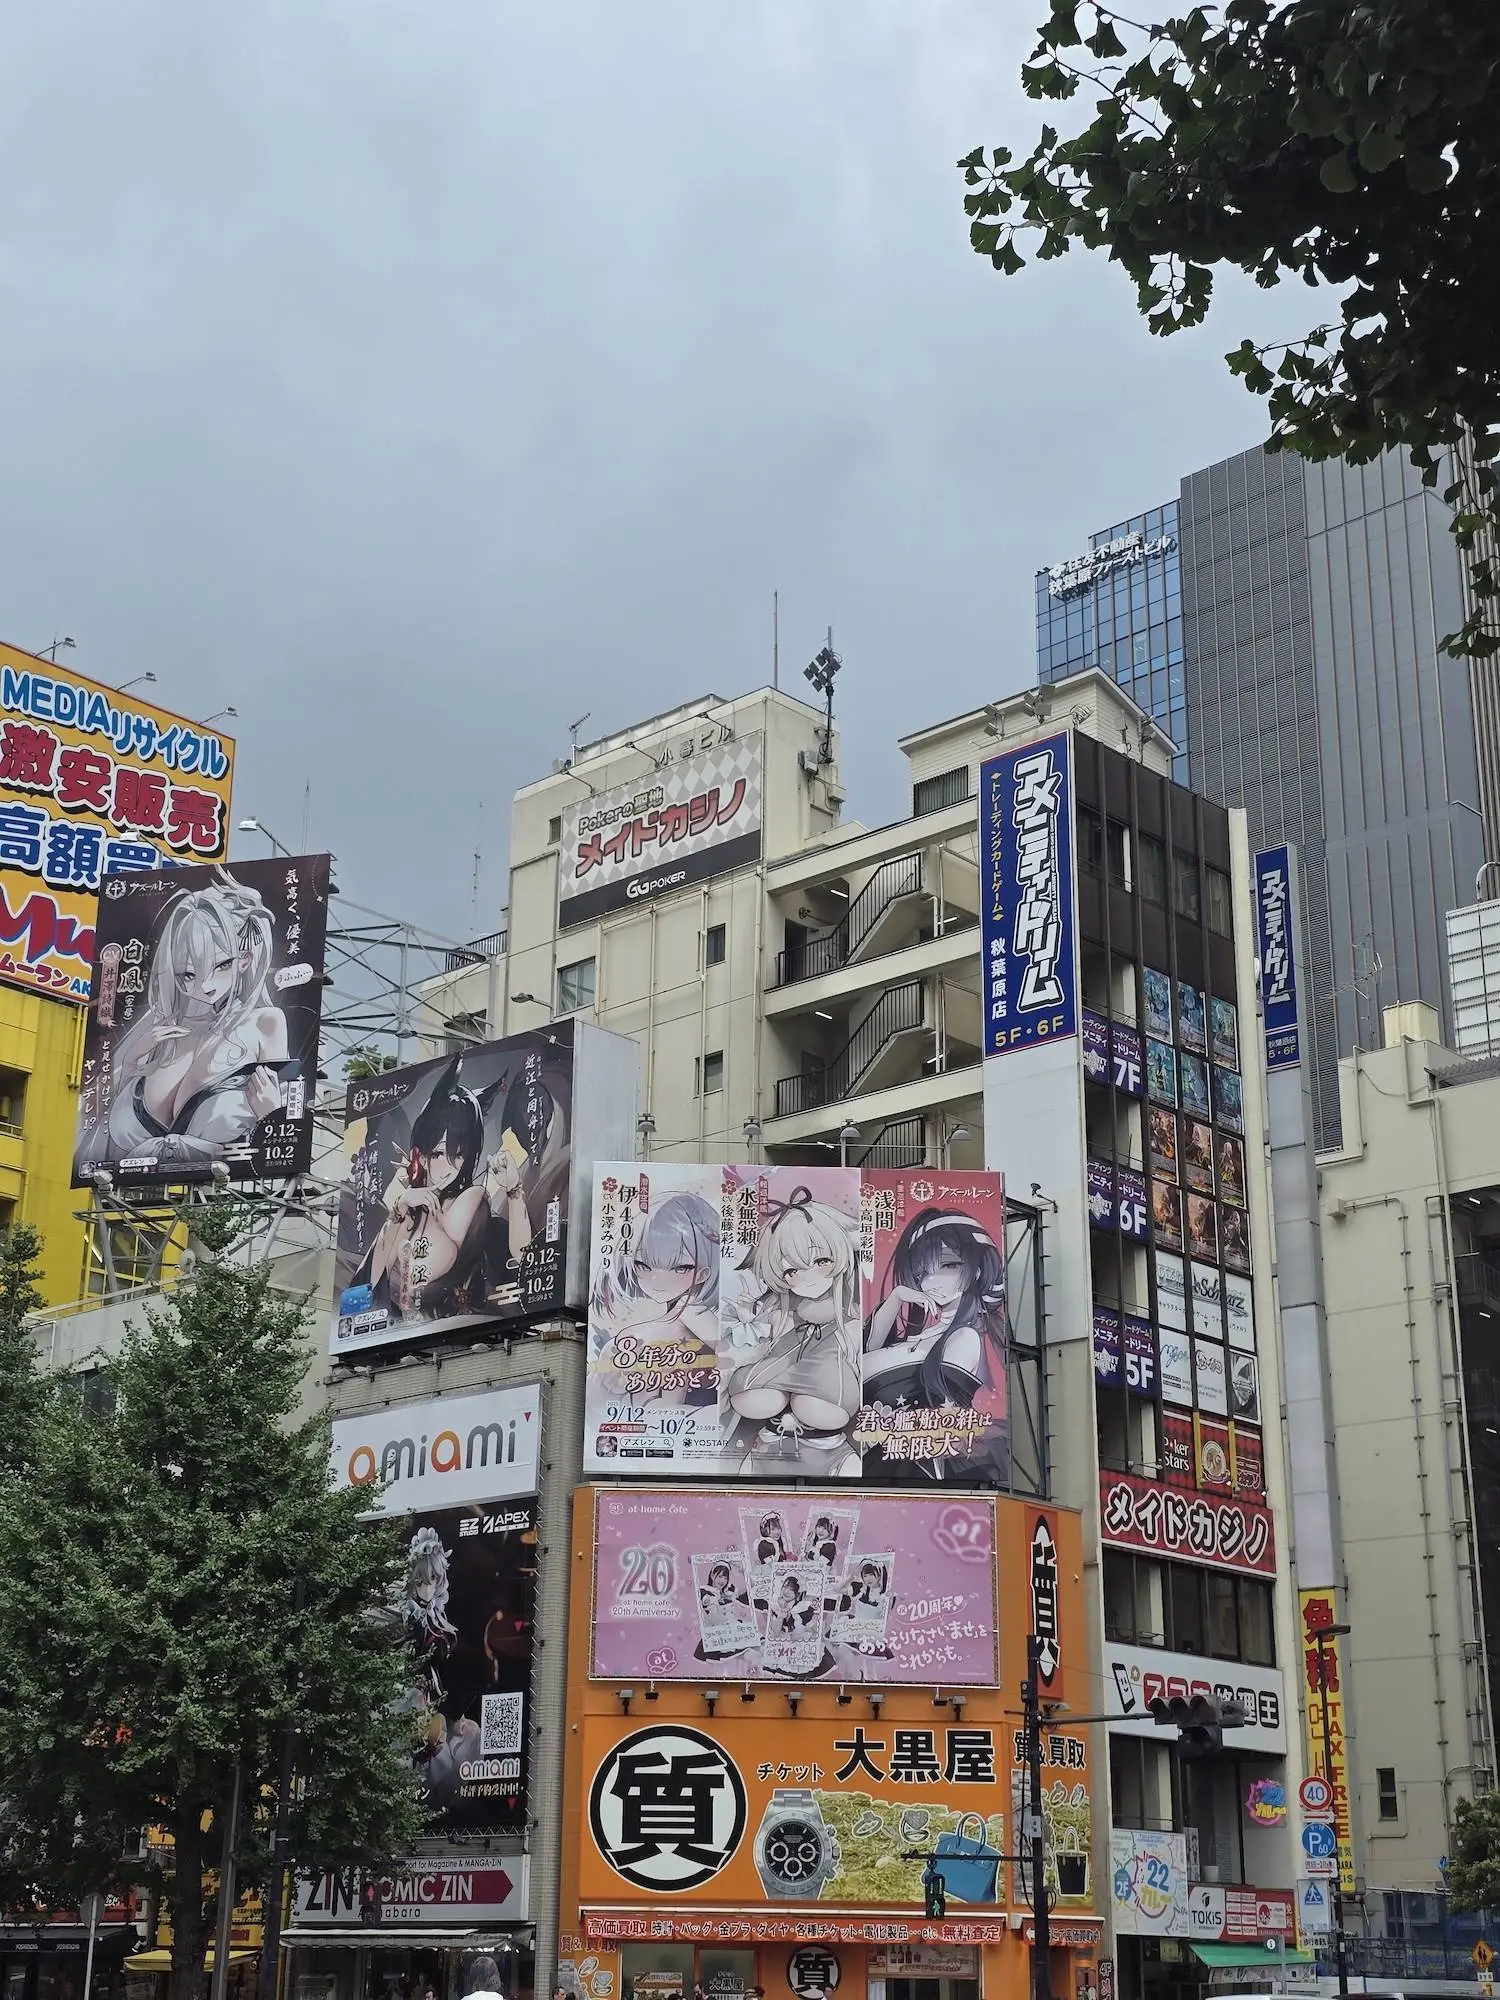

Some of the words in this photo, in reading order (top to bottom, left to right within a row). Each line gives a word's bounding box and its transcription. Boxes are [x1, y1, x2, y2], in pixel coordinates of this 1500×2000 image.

[1049, 535, 1173, 596] 秋葉原ファーストビル
[3, 667, 227, 776] MEDIAリサイクル
[0, 722, 219, 847] 激安販売
[575, 777, 747, 879] メイドカジノ
[578, 786, 664, 836] Pokerの聖地
[0, 805, 182, 884] 高額買
[0, 953, 70, 989] ムーラン
[990, 937, 1007, 1020] 秋葉原店
[1113, 1056, 1141, 1092] 7F
[264, 1145, 295, 1160] 10.2
[875, 1190, 896, 1231] 浅間
[937, 1185, 995, 1200] アズールレーン
[617, 1184, 638, 1256] 伊404
[736, 1187, 759, 1246] 水無瀬
[1119, 1200, 1147, 1235] 6F
[600, 1203, 616, 1269] 小澤みのり
[527, 1275, 554, 1294] 10.2
[613, 1336, 697, 1368] 8年分の
[1126, 1352, 1154, 1388] 5F
[626, 1368, 721, 1394] ありがとう
[607, 1406, 645, 1423] 9/12
[856, 1408, 993, 1433] 君と艦船の絆は
[348, 1419, 516, 1486] amiami
[624, 1439, 655, 1447] アズレン
[495, 1510, 530, 1526] APEX
[1104, 1482, 1269, 1565] メイドカジノ
[620, 1548, 678, 1597] 20
[633, 1607, 680, 1618] Anniversary
[1328, 1702, 1344, 1757] TAX
[460, 1758, 520, 1780] amiami
[757, 1762, 824, 1783] チケット
[834, 1727, 996, 1784] 大黒屋
[609, 1751, 727, 1870] 質
[1307, 1786, 1326, 1801] 40
[1309, 1832, 1322, 1853] P
[1318, 1843, 1329, 1854] 60
[378, 1873, 437, 1902] OMIC
[440, 1873, 474, 1902] ZIN
[1147, 1859, 1170, 1892] 22
[587, 1918, 647, 1937] 高価買取
[942, 1925, 1001, 1943] 無料査定
